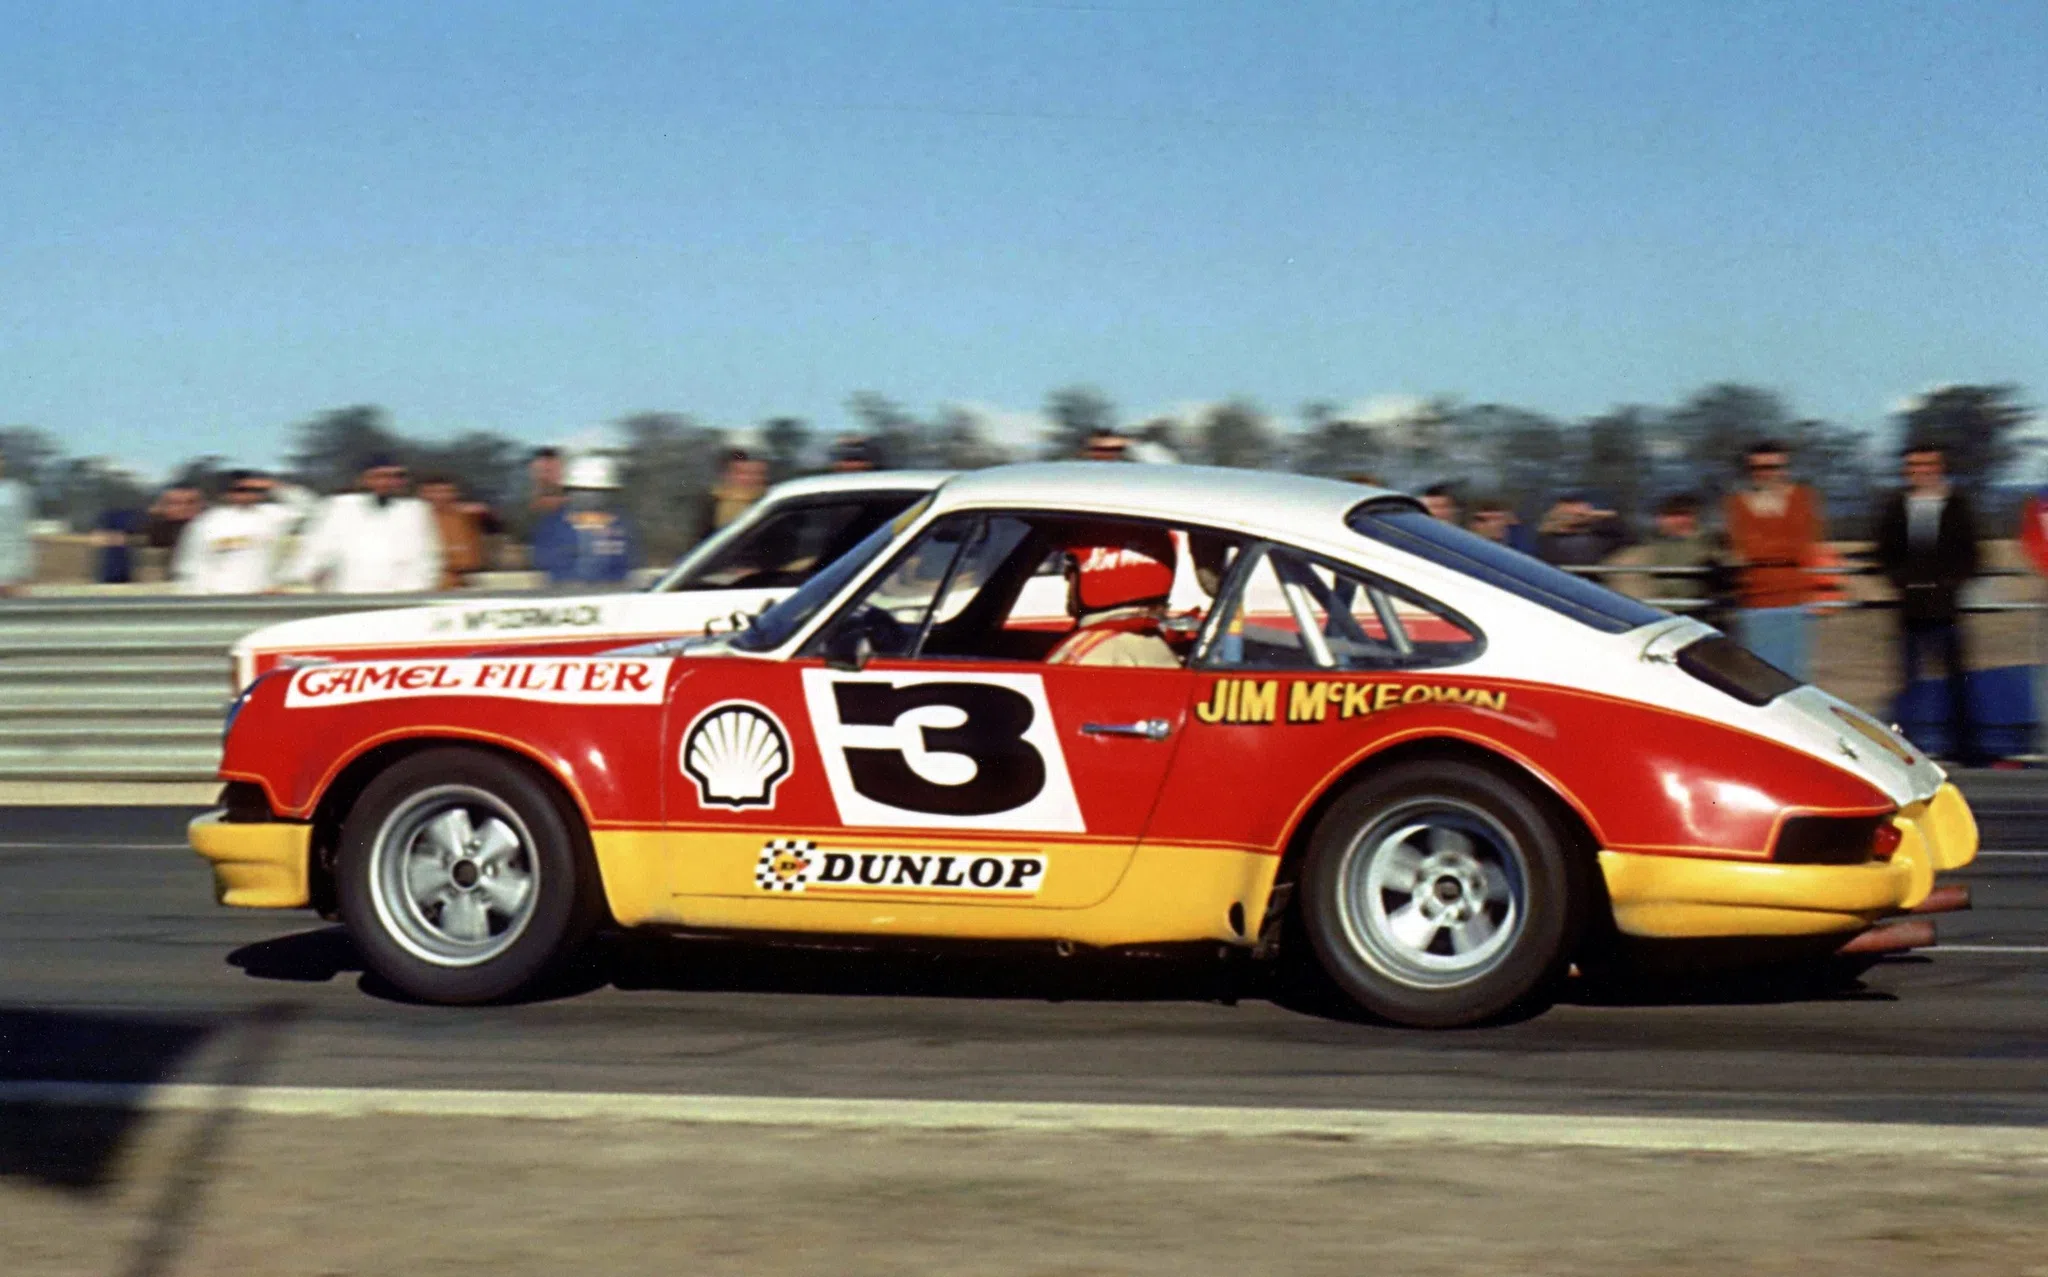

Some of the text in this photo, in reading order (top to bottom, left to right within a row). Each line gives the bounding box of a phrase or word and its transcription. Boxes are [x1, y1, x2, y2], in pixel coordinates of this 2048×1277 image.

[297, 662, 654, 698] CAMEL FILTER
[1196, 678, 1507, 723] JIM McKEOWN
[832, 681, 1046, 816] 3
[817, 852, 1043, 888] DUNLOP
